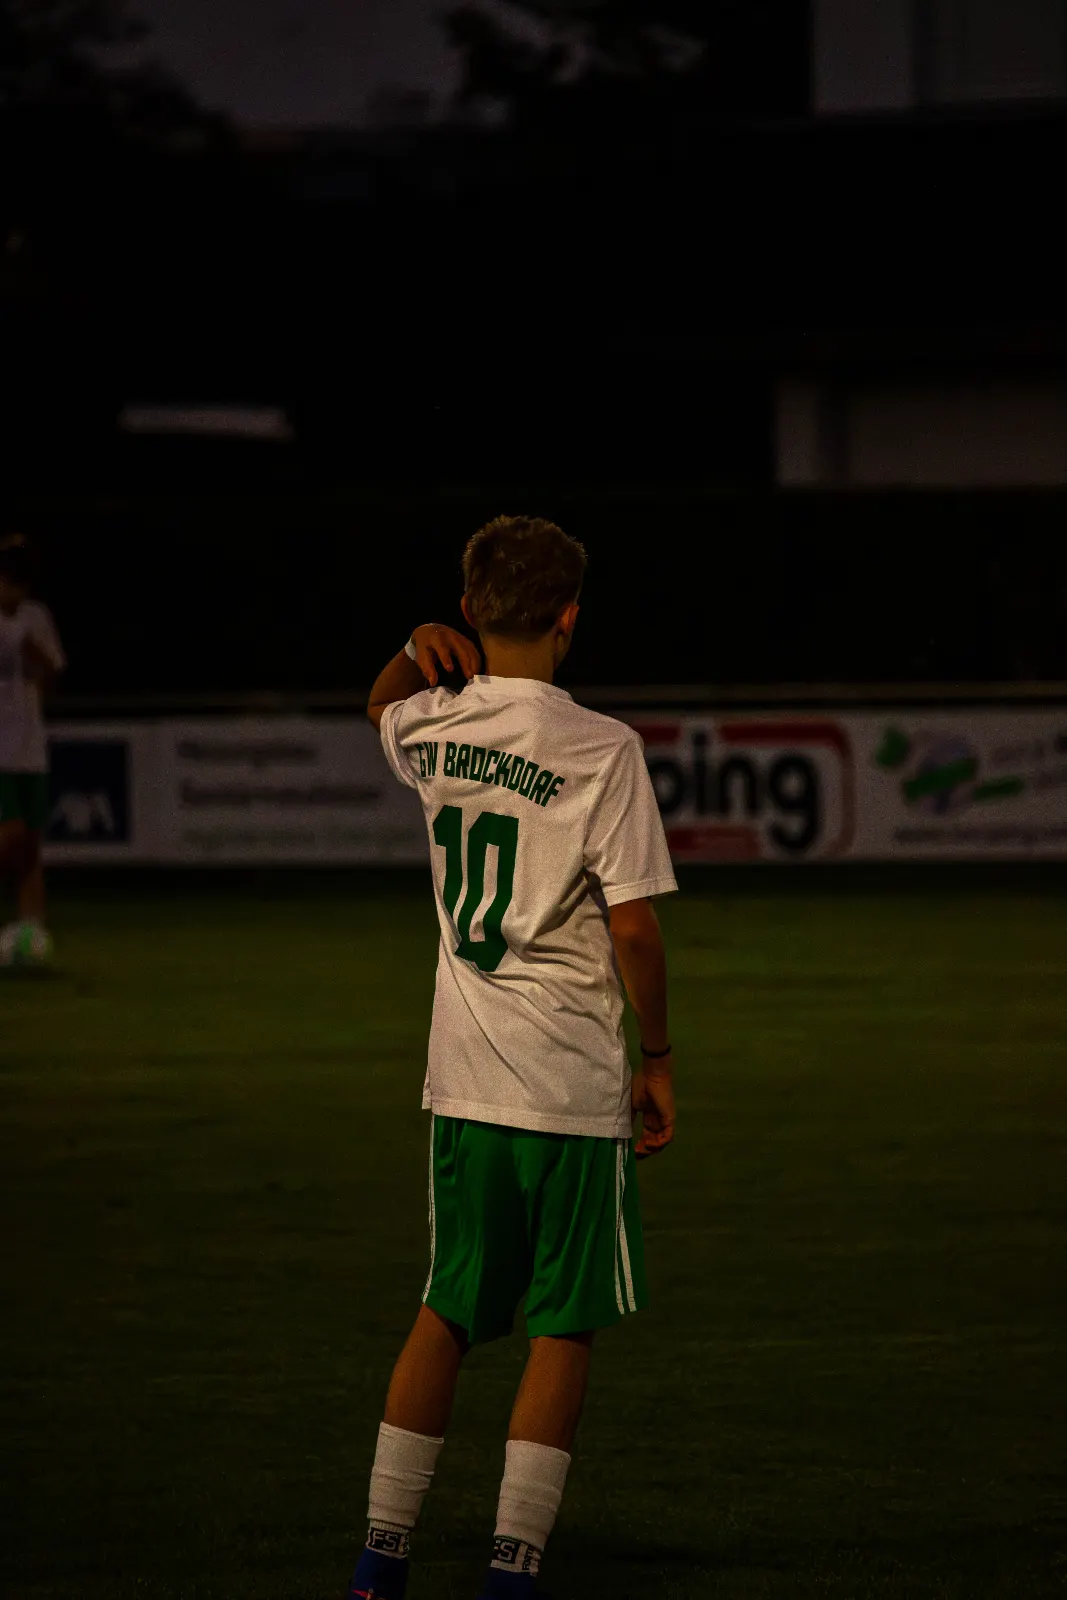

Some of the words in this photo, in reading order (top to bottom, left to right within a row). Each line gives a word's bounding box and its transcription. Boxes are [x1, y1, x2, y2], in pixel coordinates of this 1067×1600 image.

[414, 741, 438, 777] GW
[443, 741, 565, 807] BROCKDORF
[432, 804, 519, 972] 10
